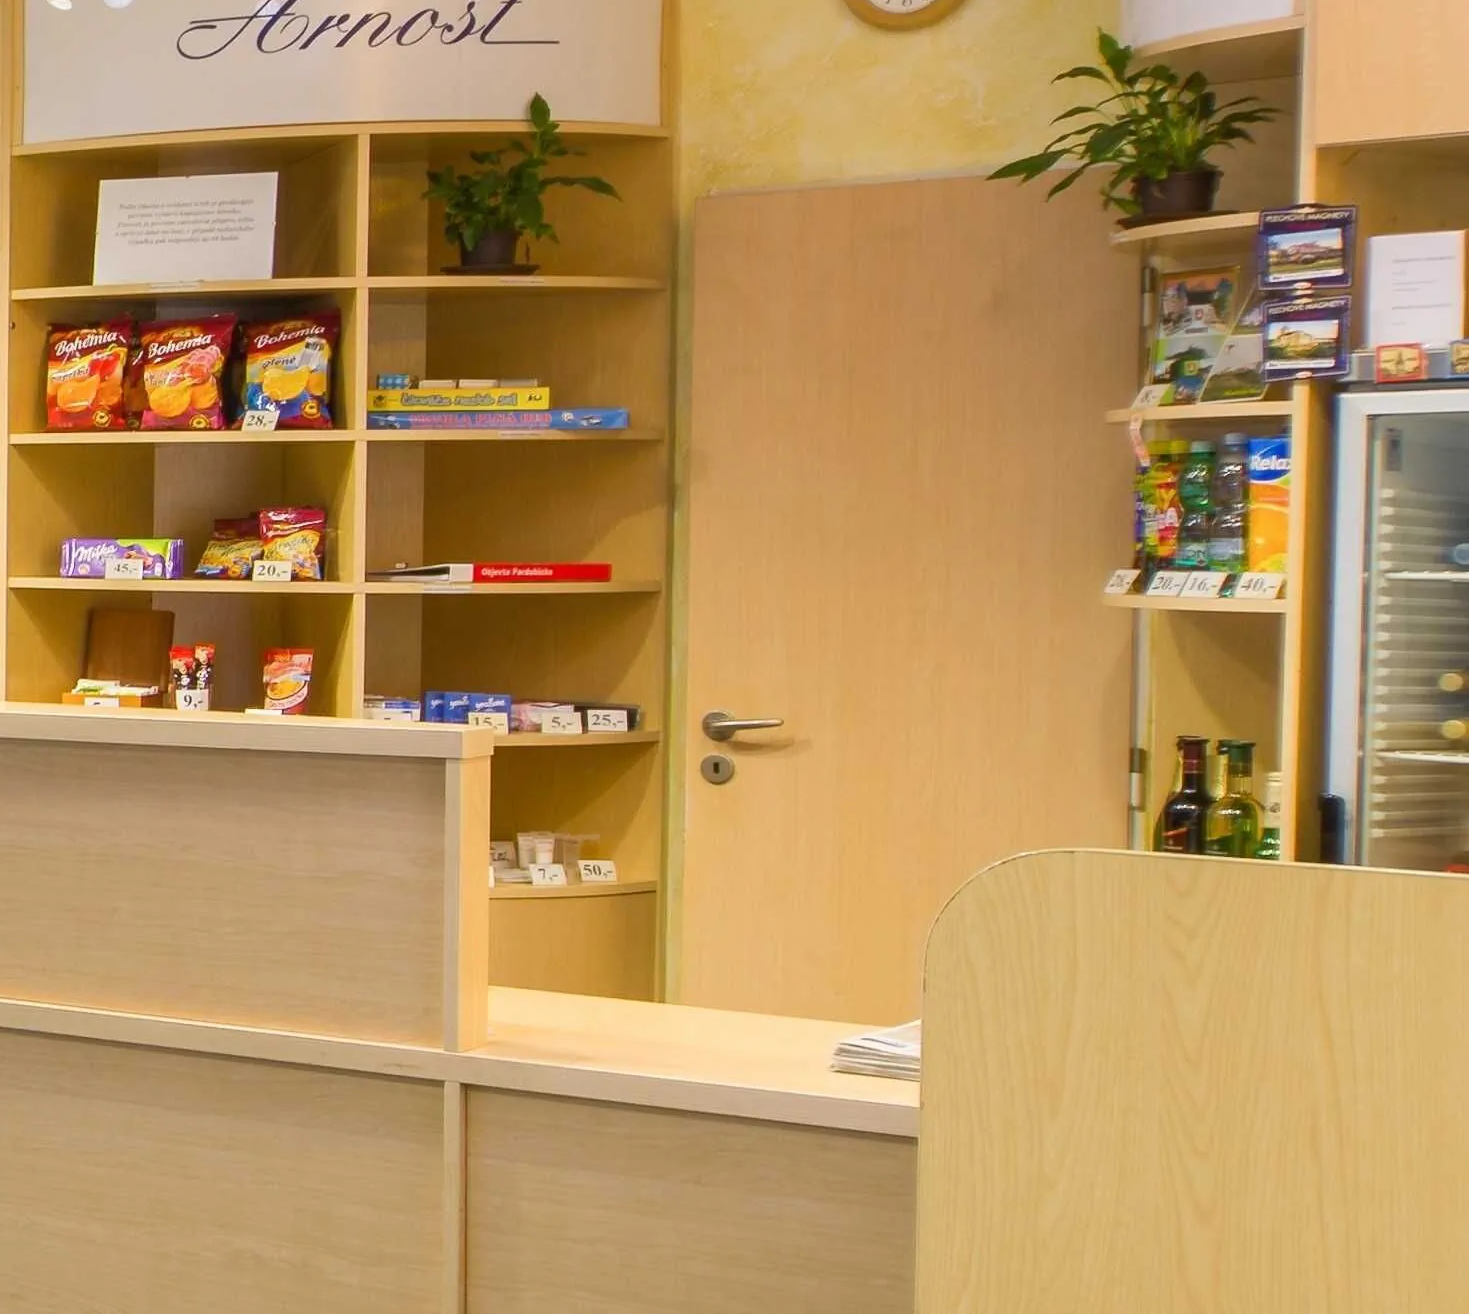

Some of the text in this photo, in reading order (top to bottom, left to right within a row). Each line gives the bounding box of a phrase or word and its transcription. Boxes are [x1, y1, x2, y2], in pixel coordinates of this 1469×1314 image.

[54, 331, 118, 357] Bohemia
[254, 325, 326, 349] Bohemia
[148, 333, 214, 359] Bohemia
[246, 415, 274, 427] 28,-
[1251, 454, 1291, 472] Rela
[74, 542, 118, 562] Milka
[257, 564, 289, 577] 20,-
[184, 694, 203, 708] 9,-
[551, 716, 574, 730] 5,-
[591, 714, 624, 727] 25,-
[583, 864, 613, 878] 50,-
